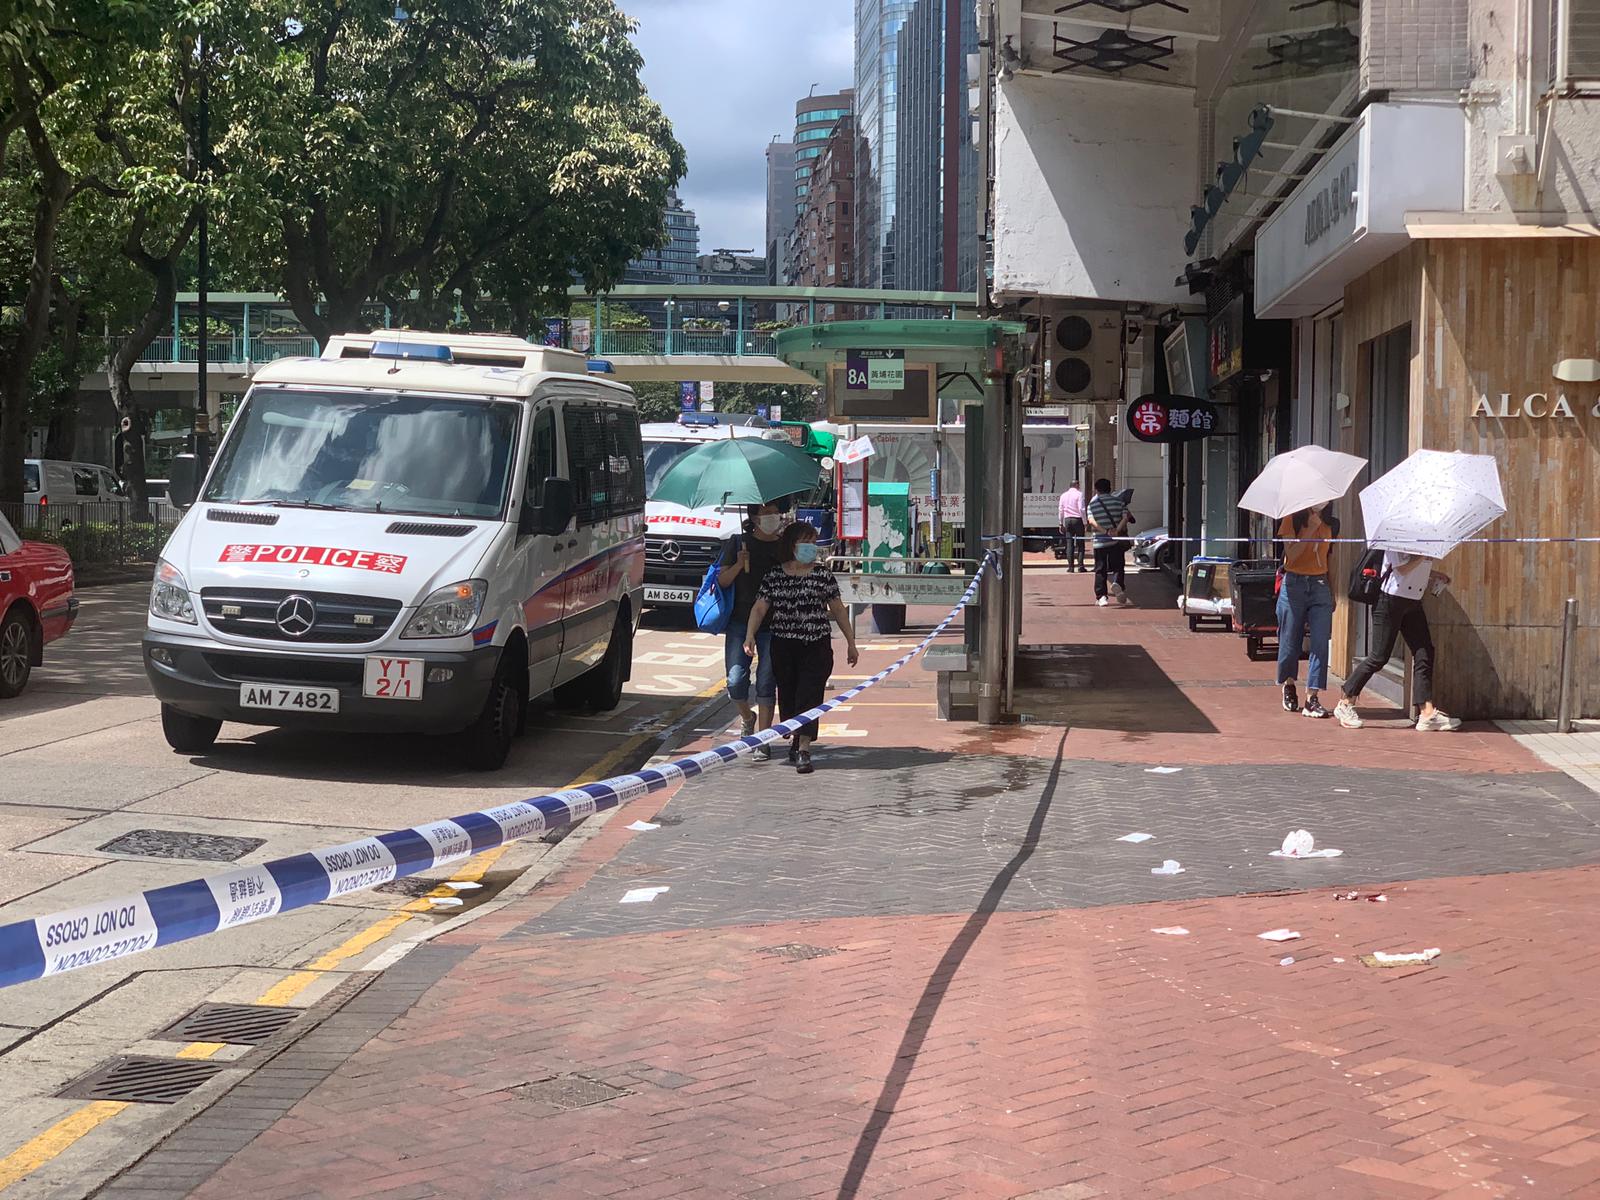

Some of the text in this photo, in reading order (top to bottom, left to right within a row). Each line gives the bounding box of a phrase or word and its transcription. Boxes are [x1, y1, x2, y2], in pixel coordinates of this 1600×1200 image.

[847, 369, 867, 384] 8A
[1471, 392, 1575, 418] ALCA
[646, 516, 704, 528] POLICE
[253, 546, 374, 569] POLICE
[647, 590, 690, 601] AM 8649
[376, 678, 411, 697] 2/1
[246, 688, 332, 710] AM 7482
[325, 844, 381, 873] DO NOT CROSS
[368, 864, 394, 884] POLICE
[46, 905, 136, 948] DO NOT CROSS
[110, 933, 153, 958] POLICE
